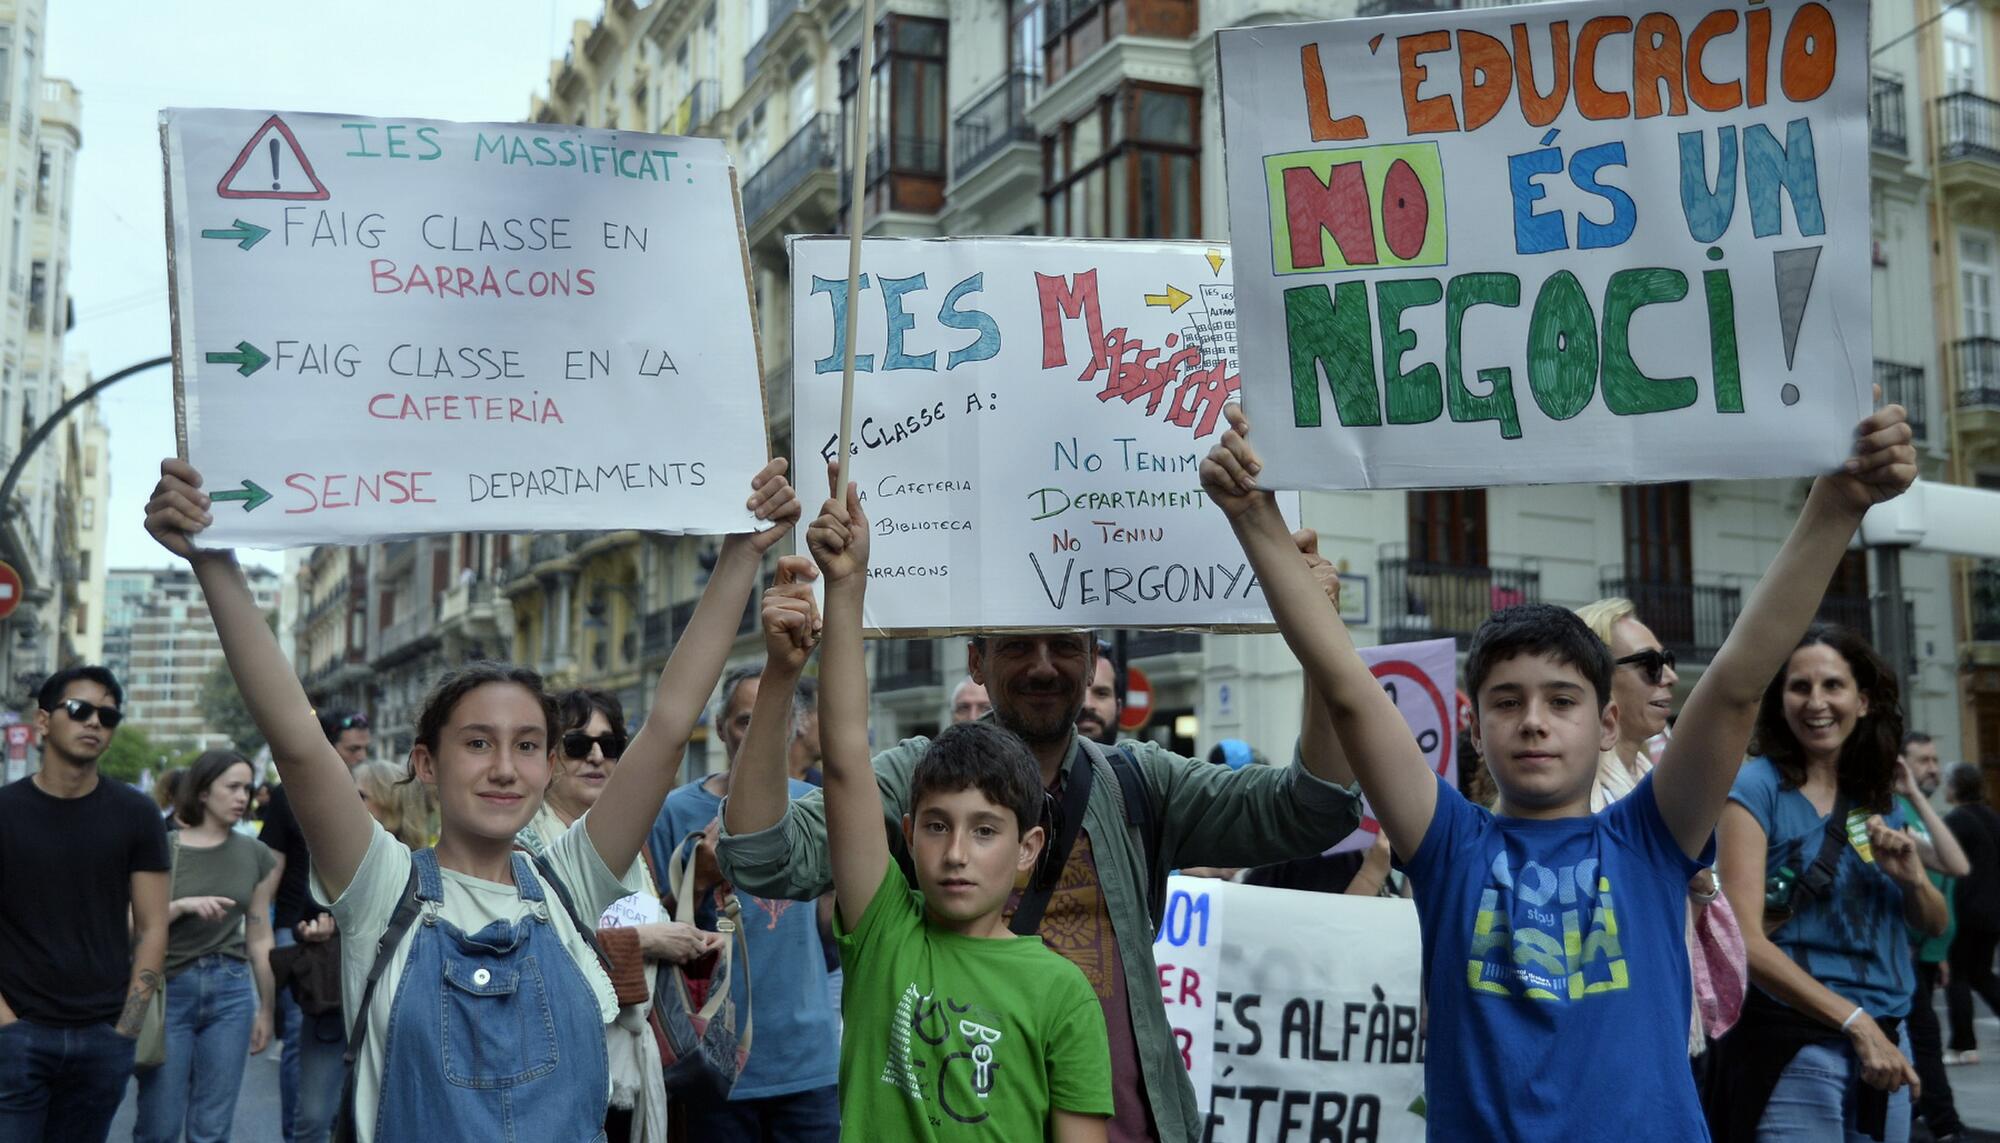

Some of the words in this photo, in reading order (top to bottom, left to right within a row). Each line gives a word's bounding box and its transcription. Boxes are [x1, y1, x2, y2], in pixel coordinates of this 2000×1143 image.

[341, 123, 442, 160] IES
[1282, 158, 1428, 268] NO
[1508, 128, 1637, 254] ÉS
[1677, 116, 1825, 243] UN
[283, 207, 386, 249] FAIG
[422, 214, 572, 252] CLASSE
[604, 222, 648, 253] EN
[370, 259, 596, 298] BARRACONS
[811, 271, 1001, 374] IES
[275, 340, 362, 378] FAIG
[388, 344, 525, 380] CLASSE
[565, 350, 609, 380] EN
[639, 350, 679, 377] LA
[861, 402, 945, 449] CLASSE
[284, 471, 437, 514] SENSE
[469, 462, 706, 503] DEPARTAMENTS
[1028, 488, 1208, 521] DEPARTAMENT
[875, 517, 972, 536] BIBLIOTECA
[867, 565, 948, 579] ARRACONS
[1155, 890, 1210, 946] 01
[1527, 908, 1555, 926] stay
